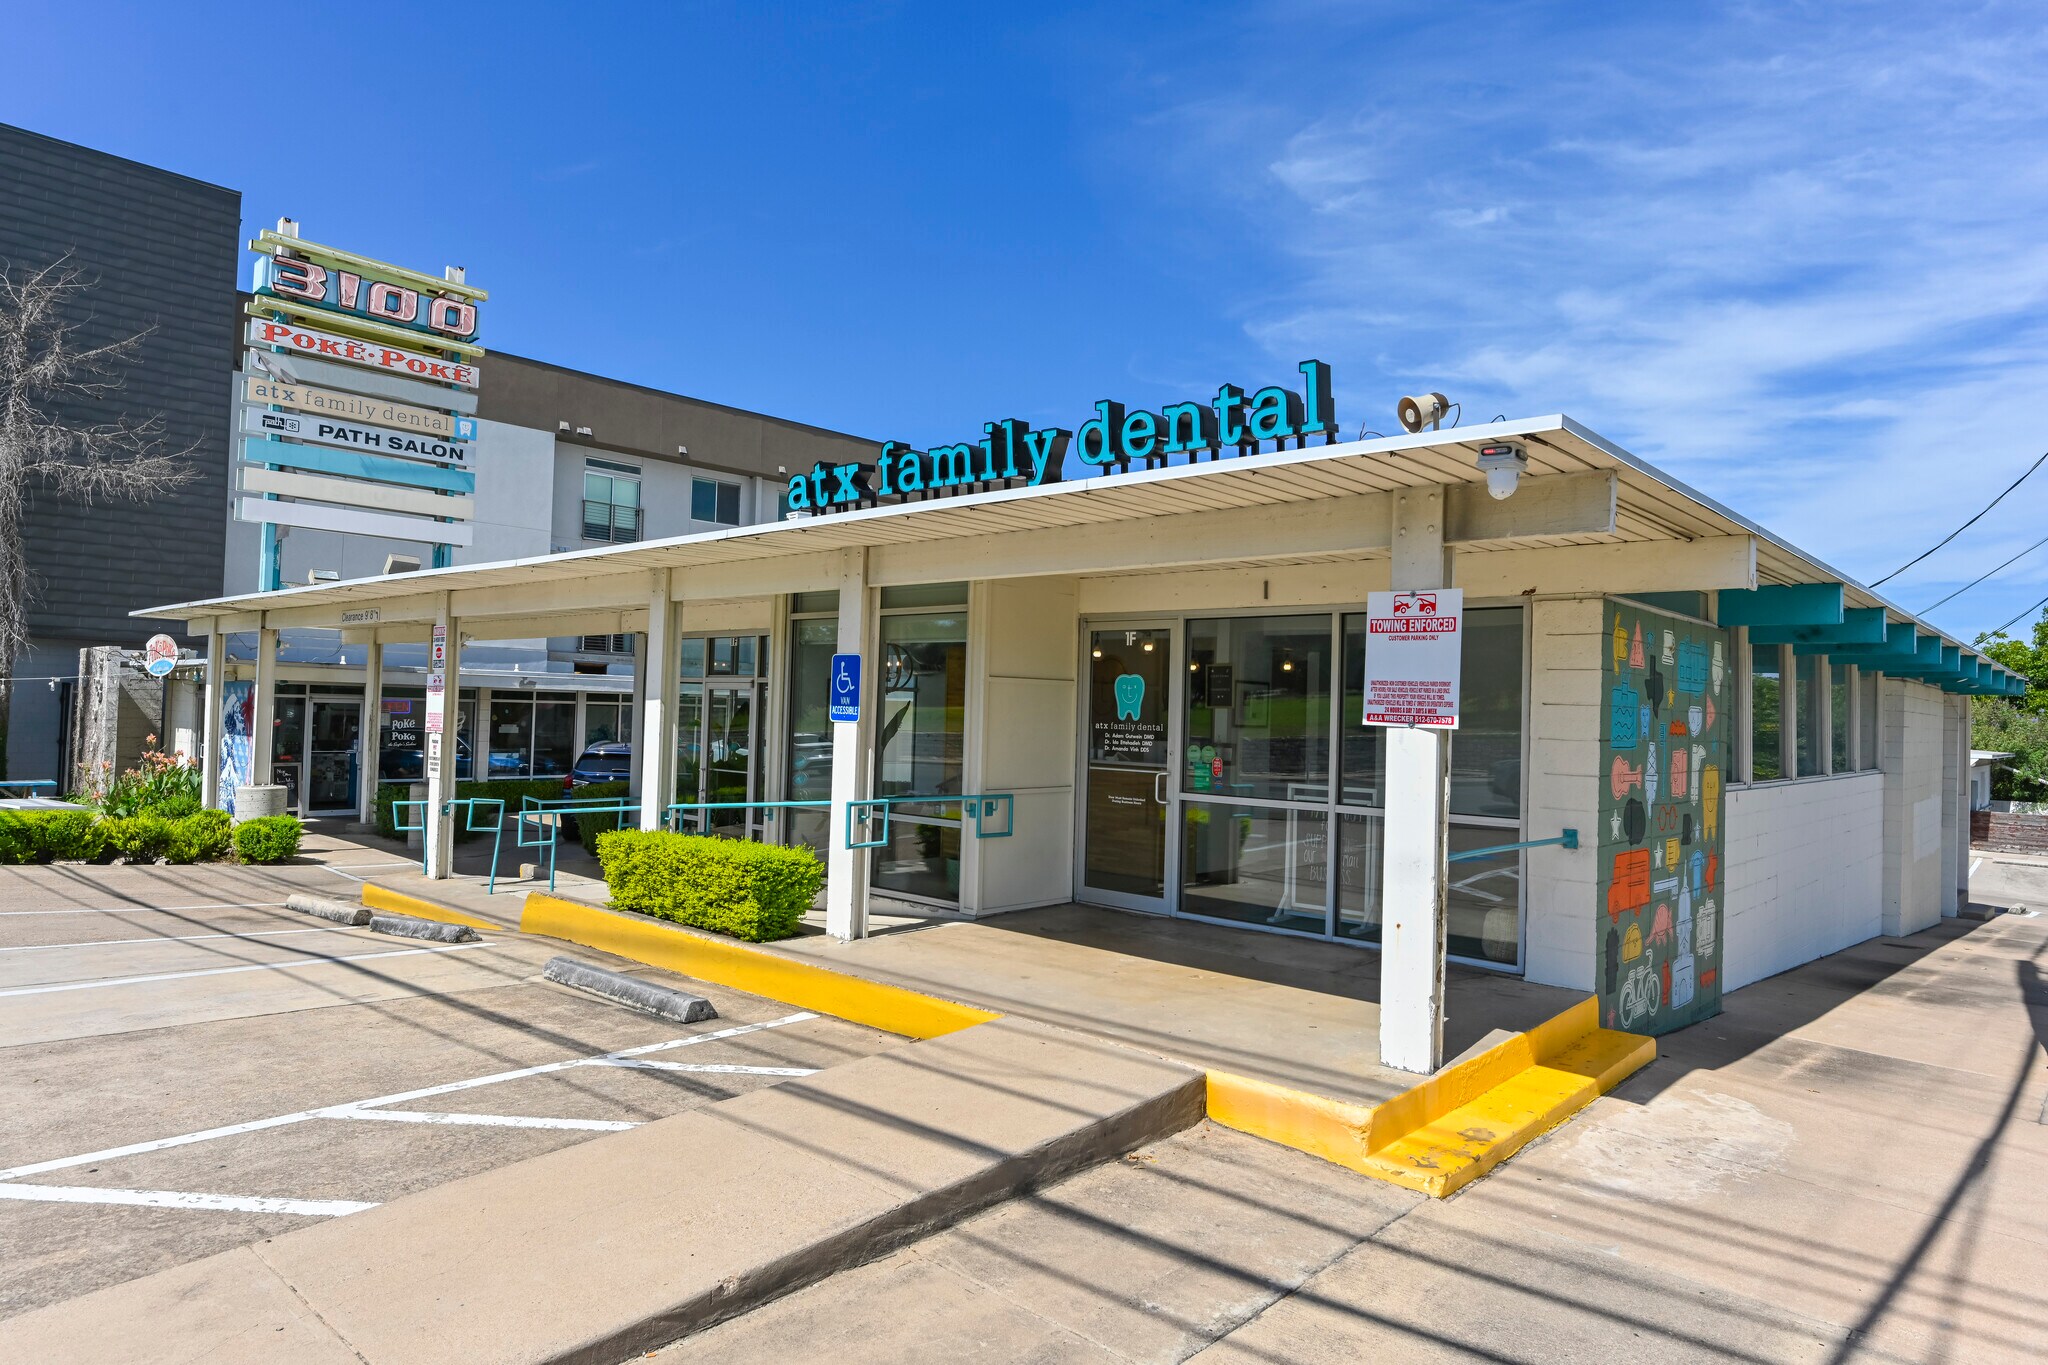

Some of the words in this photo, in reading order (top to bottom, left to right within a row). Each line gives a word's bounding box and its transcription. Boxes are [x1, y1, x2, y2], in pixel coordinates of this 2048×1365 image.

[255, 384, 296, 402] atx
[304, 390, 377, 420] family
[383, 409, 450, 432] dental
[318, 423, 380, 447] PATH
[388, 436, 465, 461] SALON
[788, 460, 864, 511] atx
[877, 418, 1062, 488] family
[1077, 359, 1328, 466] dental
[1371, 619, 1406, 632] TOWING
[1409, 618, 1455, 632] ENFORCED
[1125, 631, 1136, 646] 1F
[840, 697, 850, 705] VAN
[832, 706, 858, 715] ACCESSIBLE
[1110, 722, 1136, 732] family
[1137, 723, 1164, 732] dental
